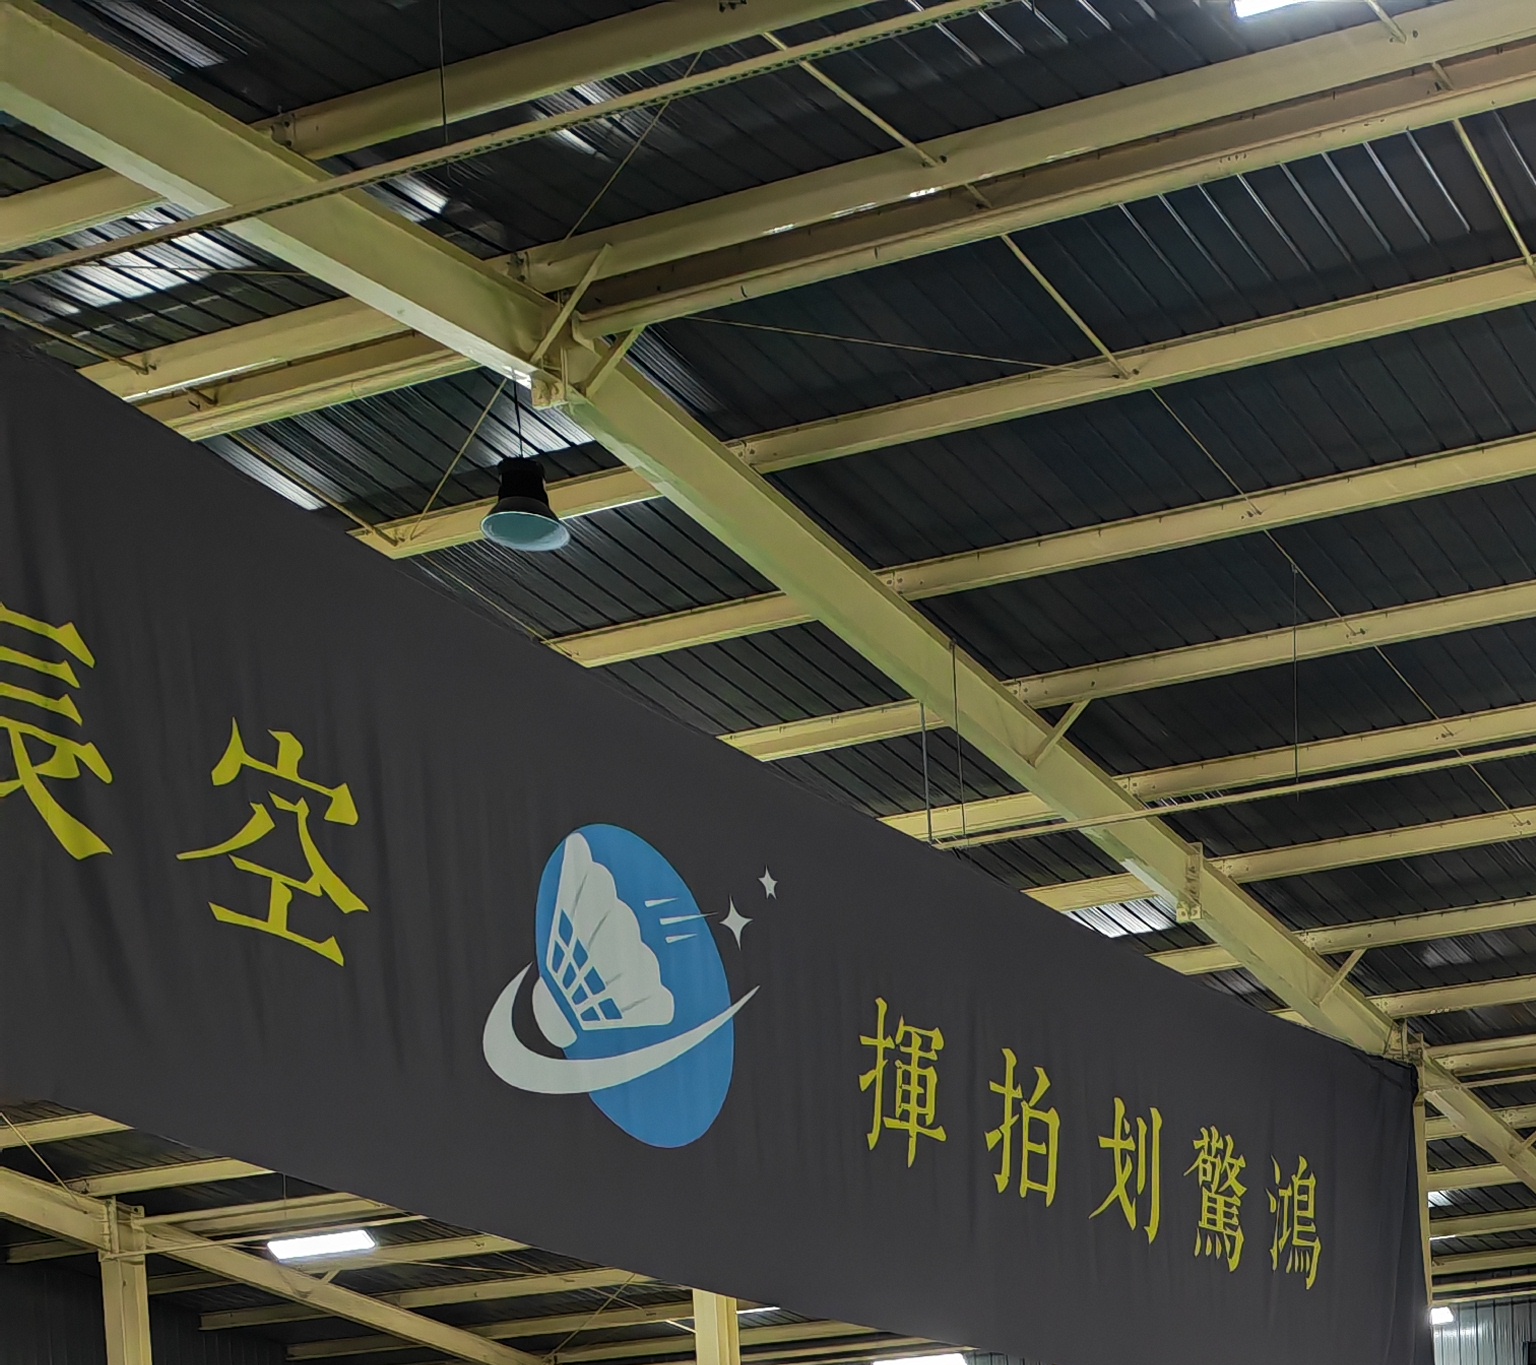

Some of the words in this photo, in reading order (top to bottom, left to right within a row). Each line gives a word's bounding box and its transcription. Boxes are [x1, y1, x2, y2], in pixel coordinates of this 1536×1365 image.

[858, 997, 1323, 1290] 揮拍划驚鴻
